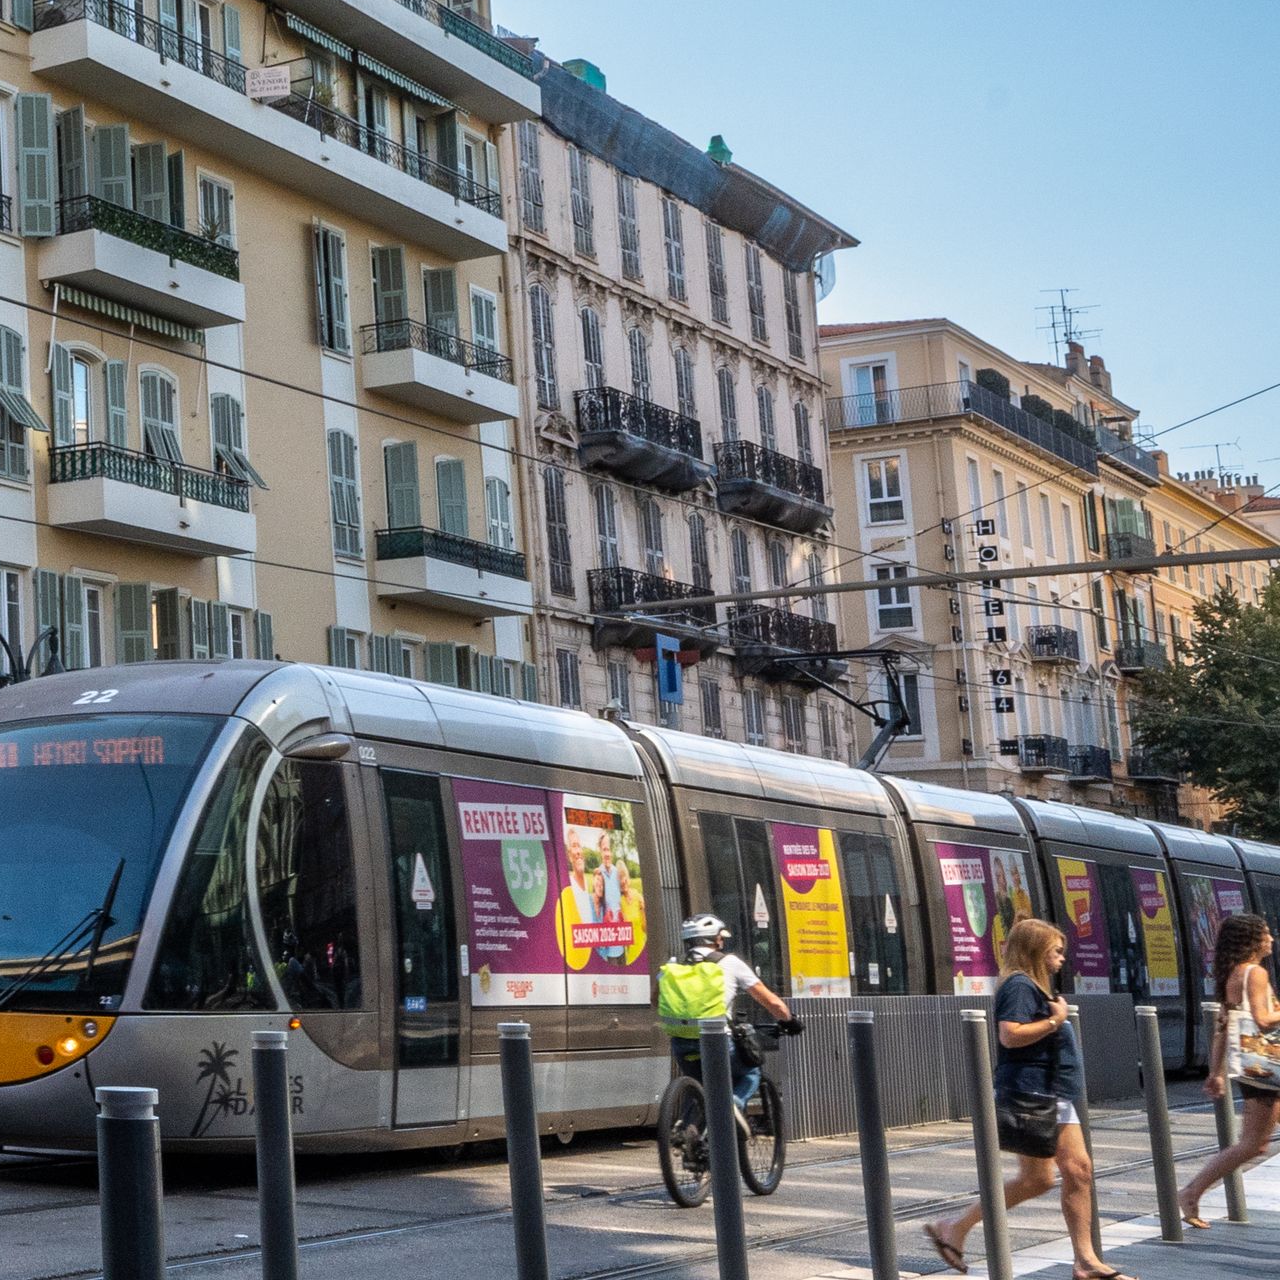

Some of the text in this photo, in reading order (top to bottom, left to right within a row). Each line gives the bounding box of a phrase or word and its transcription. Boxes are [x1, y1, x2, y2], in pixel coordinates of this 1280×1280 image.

[73, 689, 120, 705] 22
[462, 805, 545, 835] RENTRÉE DES
[507, 847, 547, 890] 55+
[573, 928, 599, 943] SAISON
[99, 995, 112, 1005] 22
